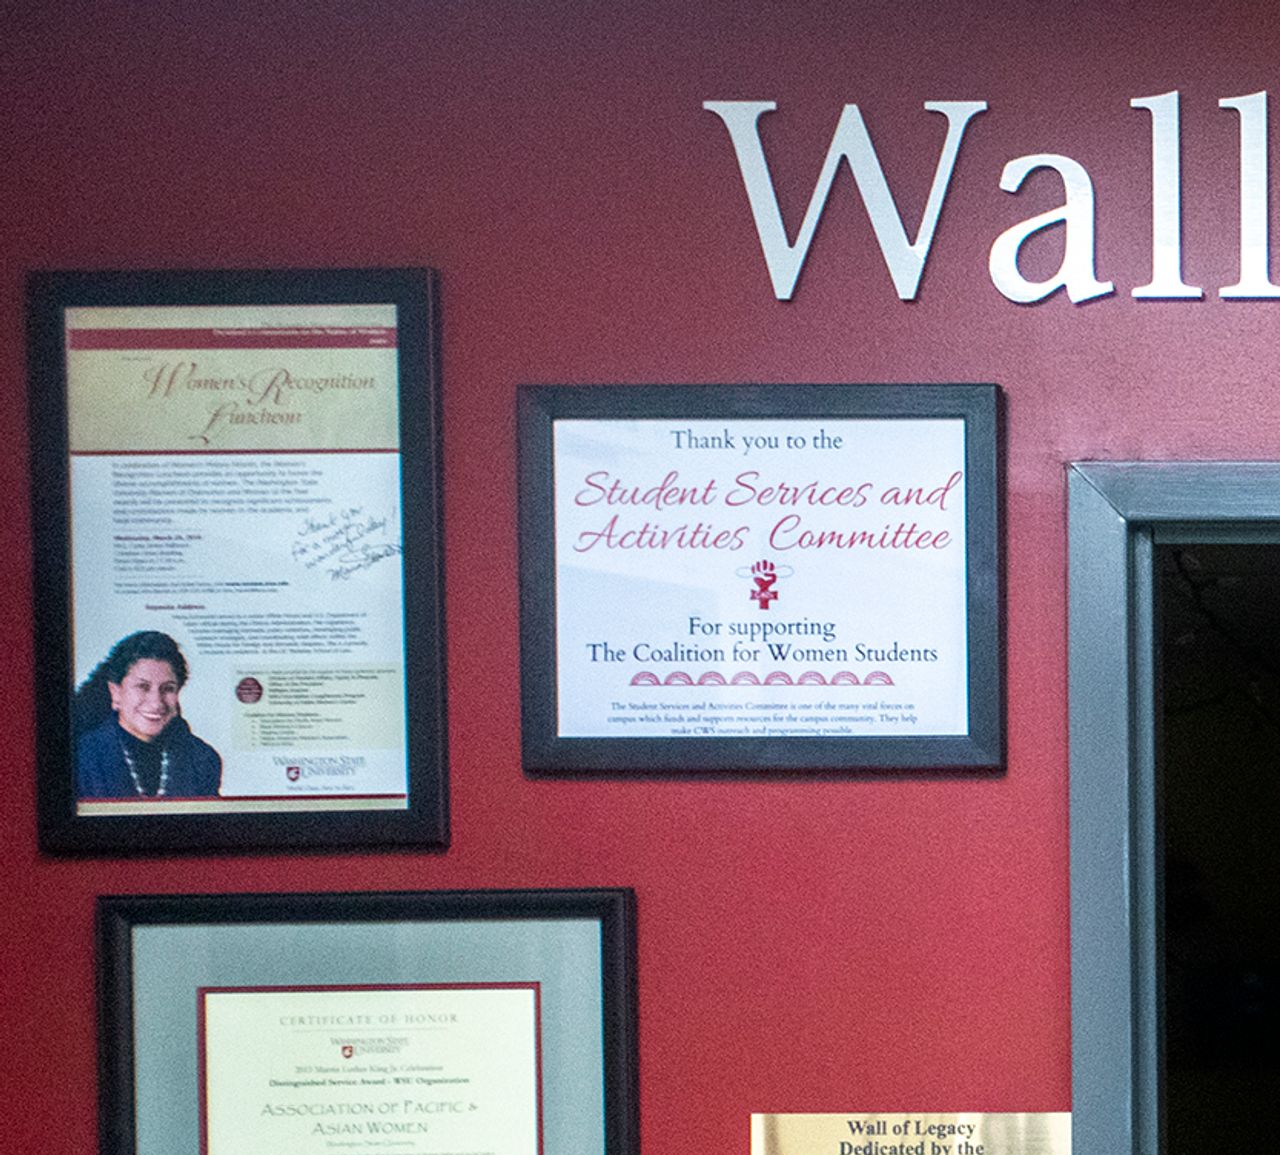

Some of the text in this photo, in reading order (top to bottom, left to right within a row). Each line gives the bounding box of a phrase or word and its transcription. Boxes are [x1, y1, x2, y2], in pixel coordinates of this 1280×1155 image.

[247, 367, 375, 404] Recognition
[670, 428, 844, 456] Thank you to the
[574, 470, 963, 512] Student Services and
[573, 514, 951, 553] Activities Committee
[688, 616, 837, 643] For supporting
[586, 641, 938, 664] The Coalition for Women Students
[279, 1012, 459, 1026] CERTIFICATE OF HONOR
[260, 1103, 374, 1117] ASSOCIATION
[378, 1103, 399, 1115] OF
[403, 1100, 463, 1114] PACIFIC
[312, 1121, 428, 1136] ASIAN WOMEN
[847, 1121, 975, 1139] Wall of Legacy
[957, 1141, 984, 1155] the
